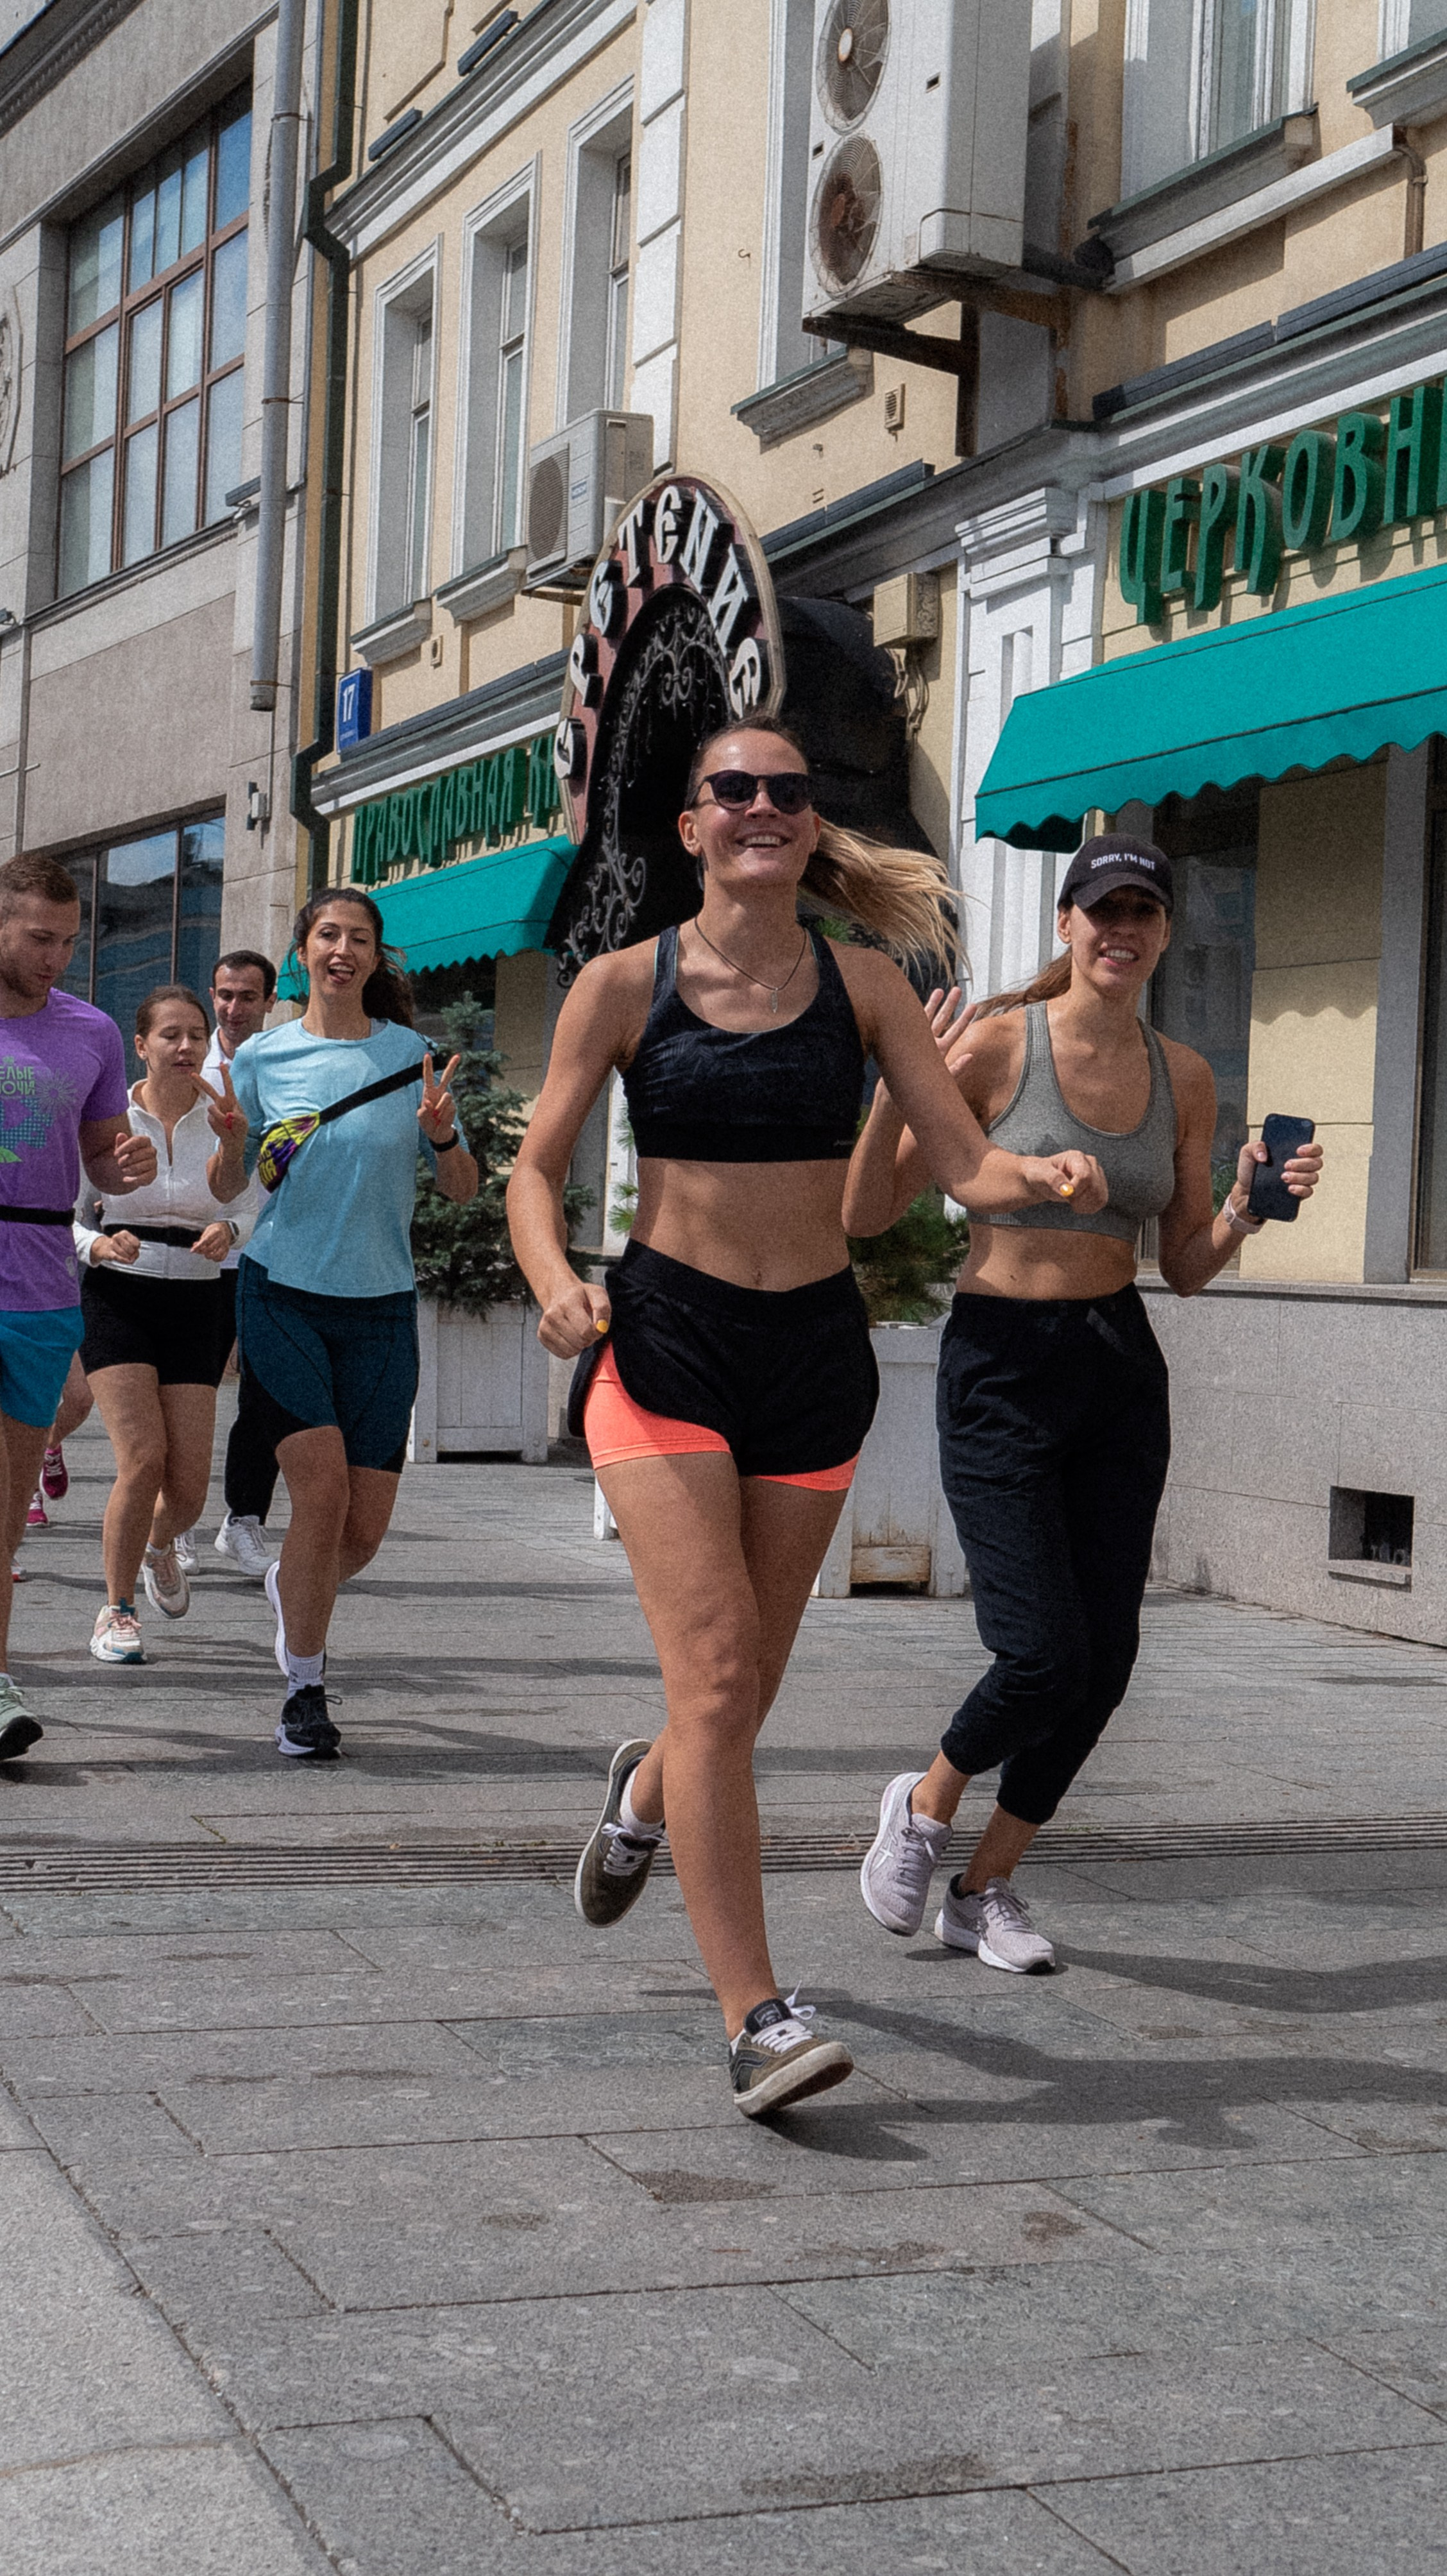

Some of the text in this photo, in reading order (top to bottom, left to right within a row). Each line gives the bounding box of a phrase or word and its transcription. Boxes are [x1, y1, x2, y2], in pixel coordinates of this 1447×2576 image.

[1119, 375, 1447, 624] ЦЕРКОВН
[343, 683, 356, 723] 17
[351, 747, 521, 884] ПРАВОСЛАВНАЯ
[1091, 852, 1156, 870] SORRY, I'M NOT
[0, 1065, 35, 1080] ЕЛЫЕ
[0, 1080, 35, 1095] ОЧИ
